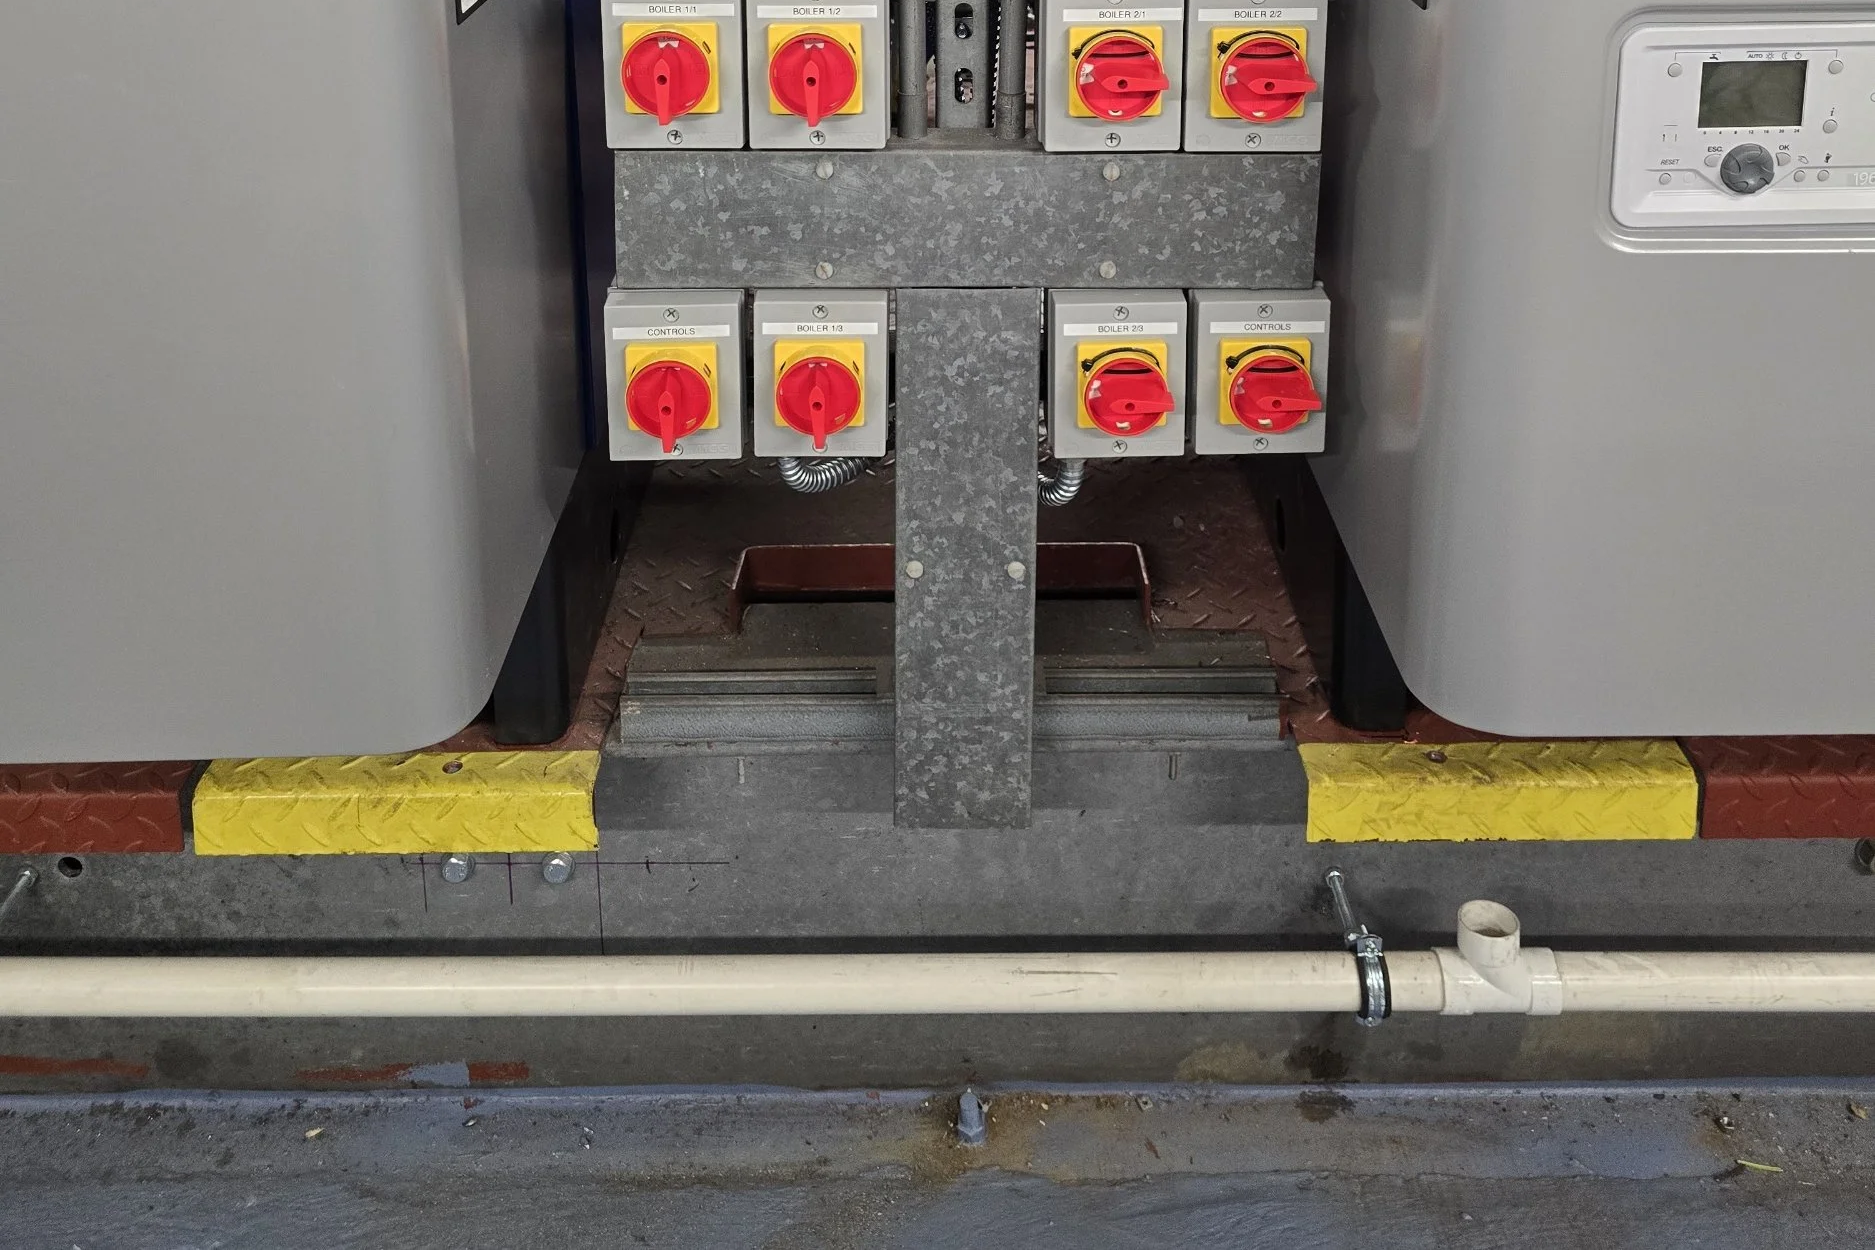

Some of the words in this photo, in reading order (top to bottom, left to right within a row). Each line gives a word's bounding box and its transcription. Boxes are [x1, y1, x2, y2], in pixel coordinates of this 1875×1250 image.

[648, 5, 683, 14] BOILER
[684, 5, 698, 14] 1/1
[792, 7, 826, 16] BOILER
[828, 7, 841, 16] 1/2
[1098, 10, 1132, 19] BOILER
[1133, 10, 1146, 19] 2/1
[1234, 10, 1267, 19] BOILER
[1269, 10, 1282, 18] 2/2
[796, 324, 829, 333] BOILER
[831, 323, 844, 332] 1/3
[1097, 324, 1130, 333] BOILER
[1131, 324, 1144, 332] 2/3
[1244, 322, 1292, 332] CONTROLS
[647, 327, 696, 337] CONTROLS
